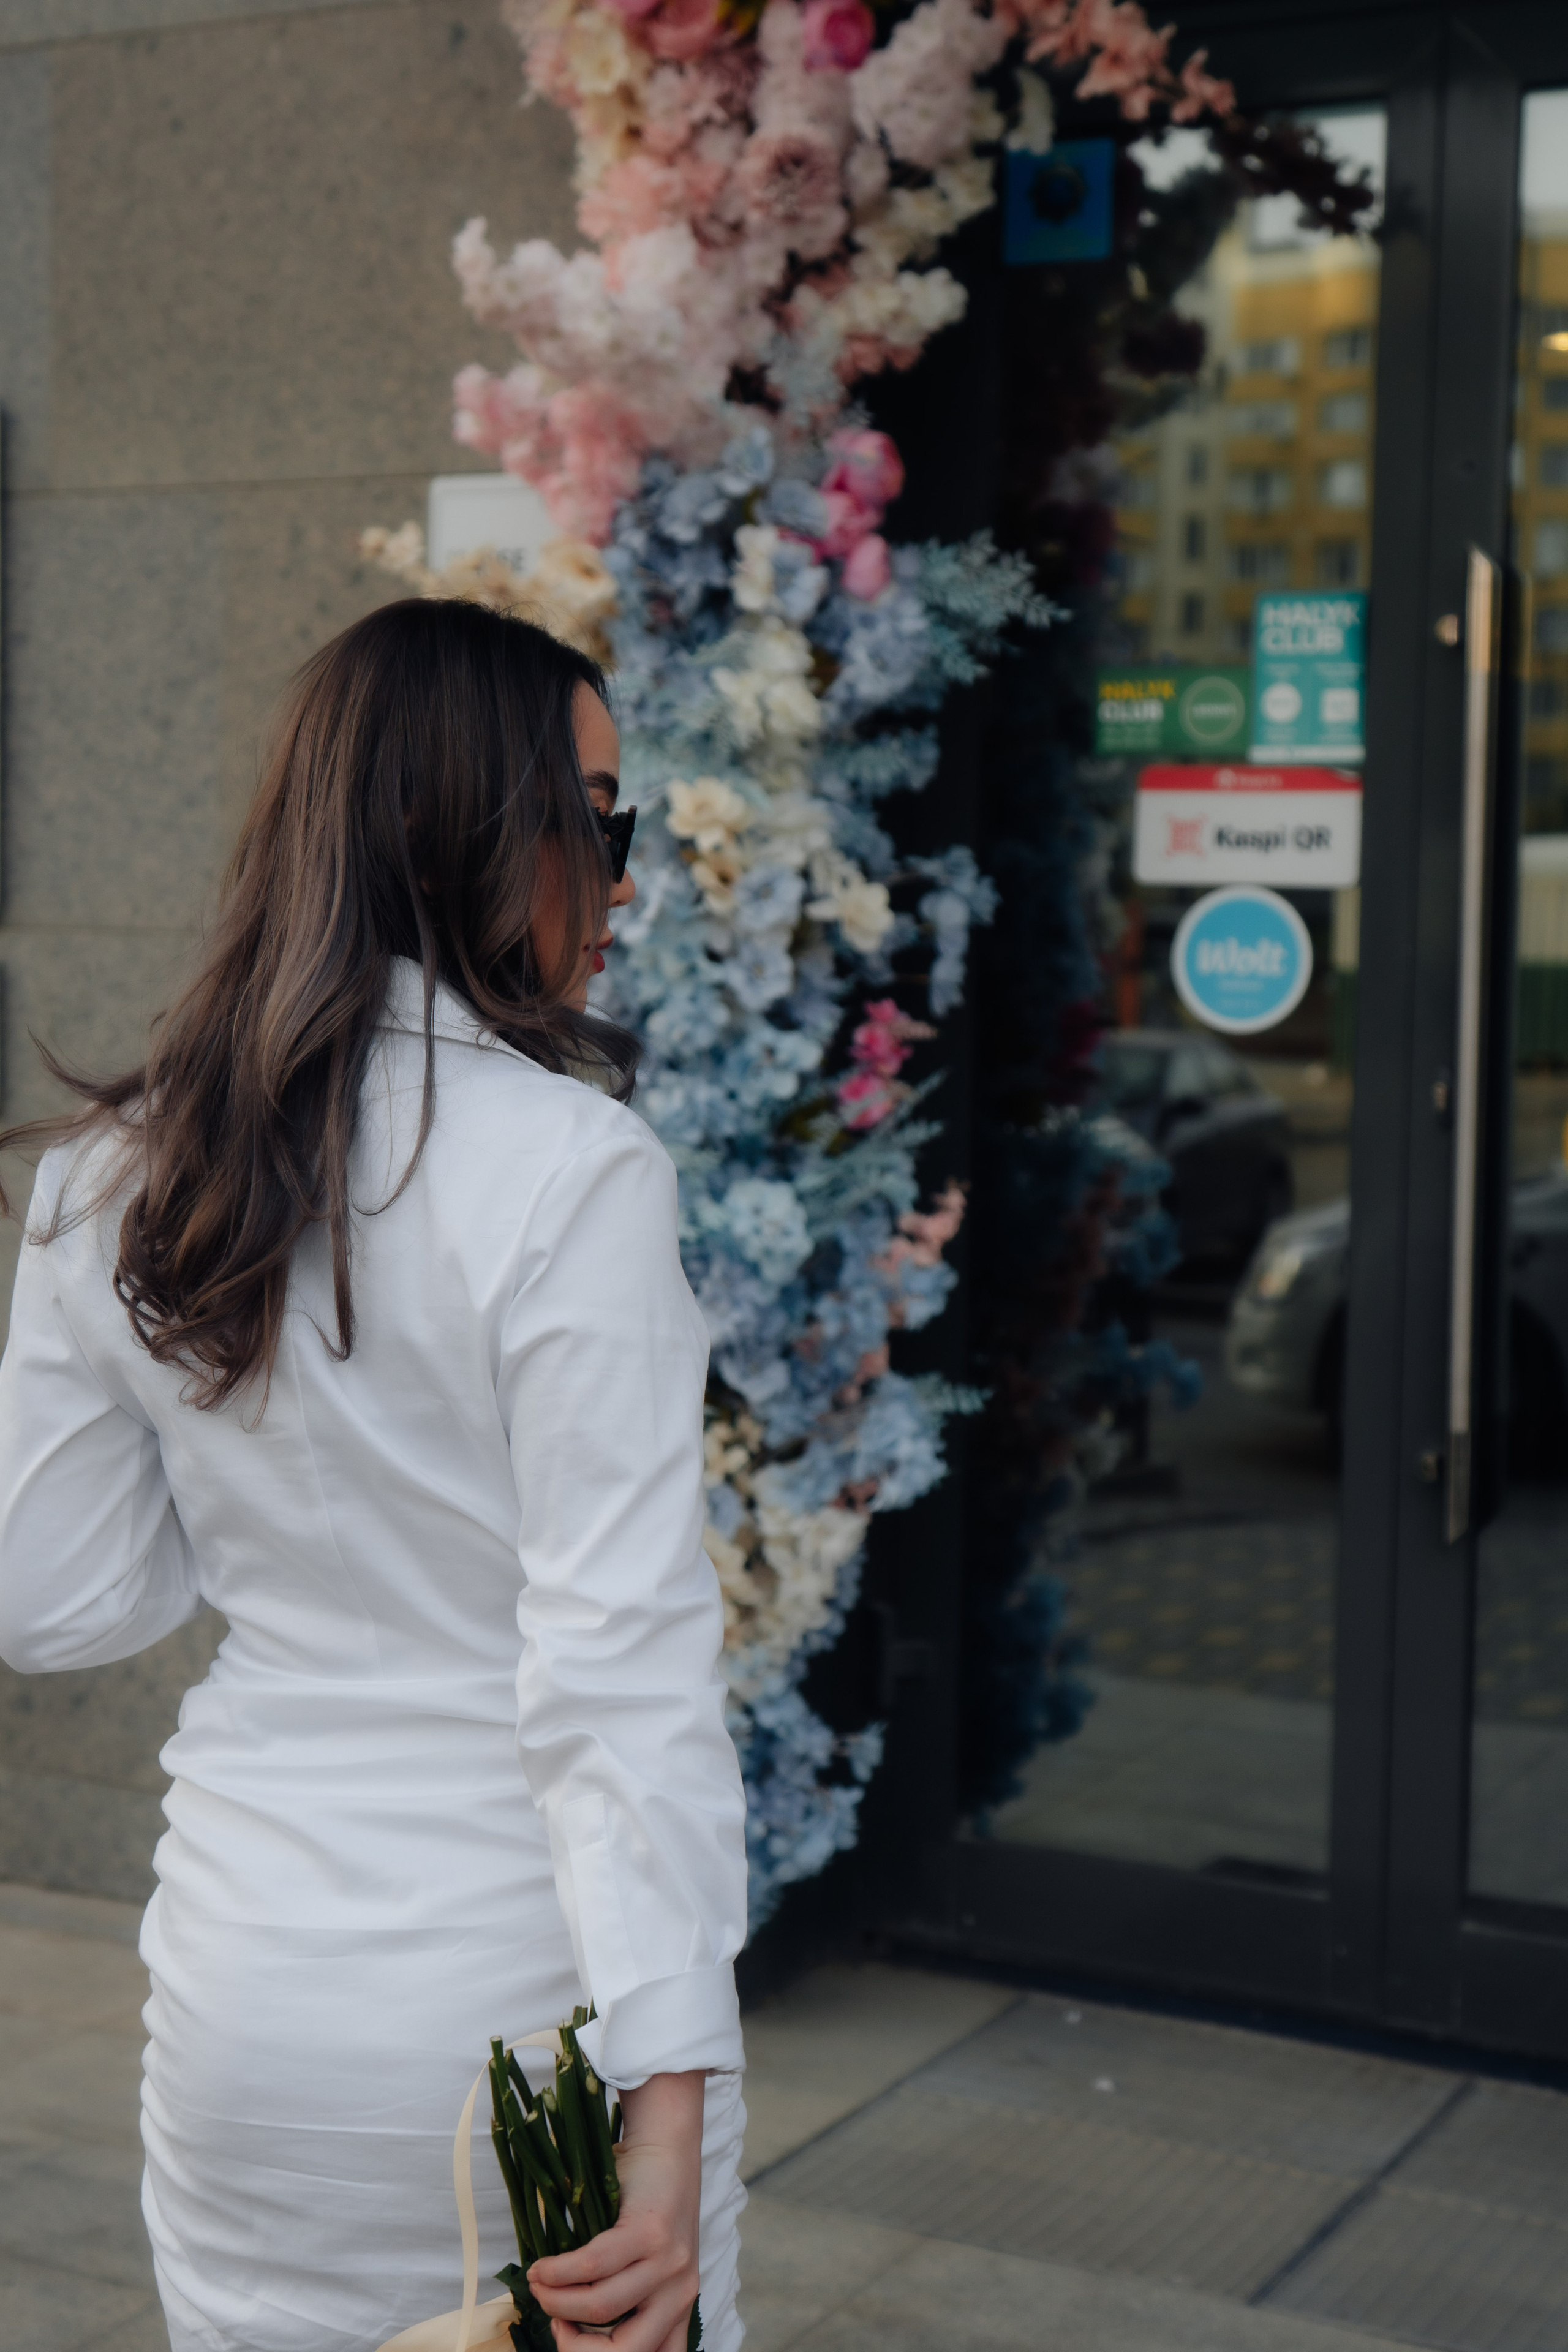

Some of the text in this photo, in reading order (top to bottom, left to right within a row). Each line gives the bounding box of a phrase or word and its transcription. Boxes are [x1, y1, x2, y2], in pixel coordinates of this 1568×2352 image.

[1263, 601, 1359, 625] HALYK
[1262, 627, 1343, 654] CLUB
[1099, 701, 1162, 722] CLUB
[1216, 826, 1330, 853] Kaspi QR
[1196, 937, 1286, 977] Wolt
